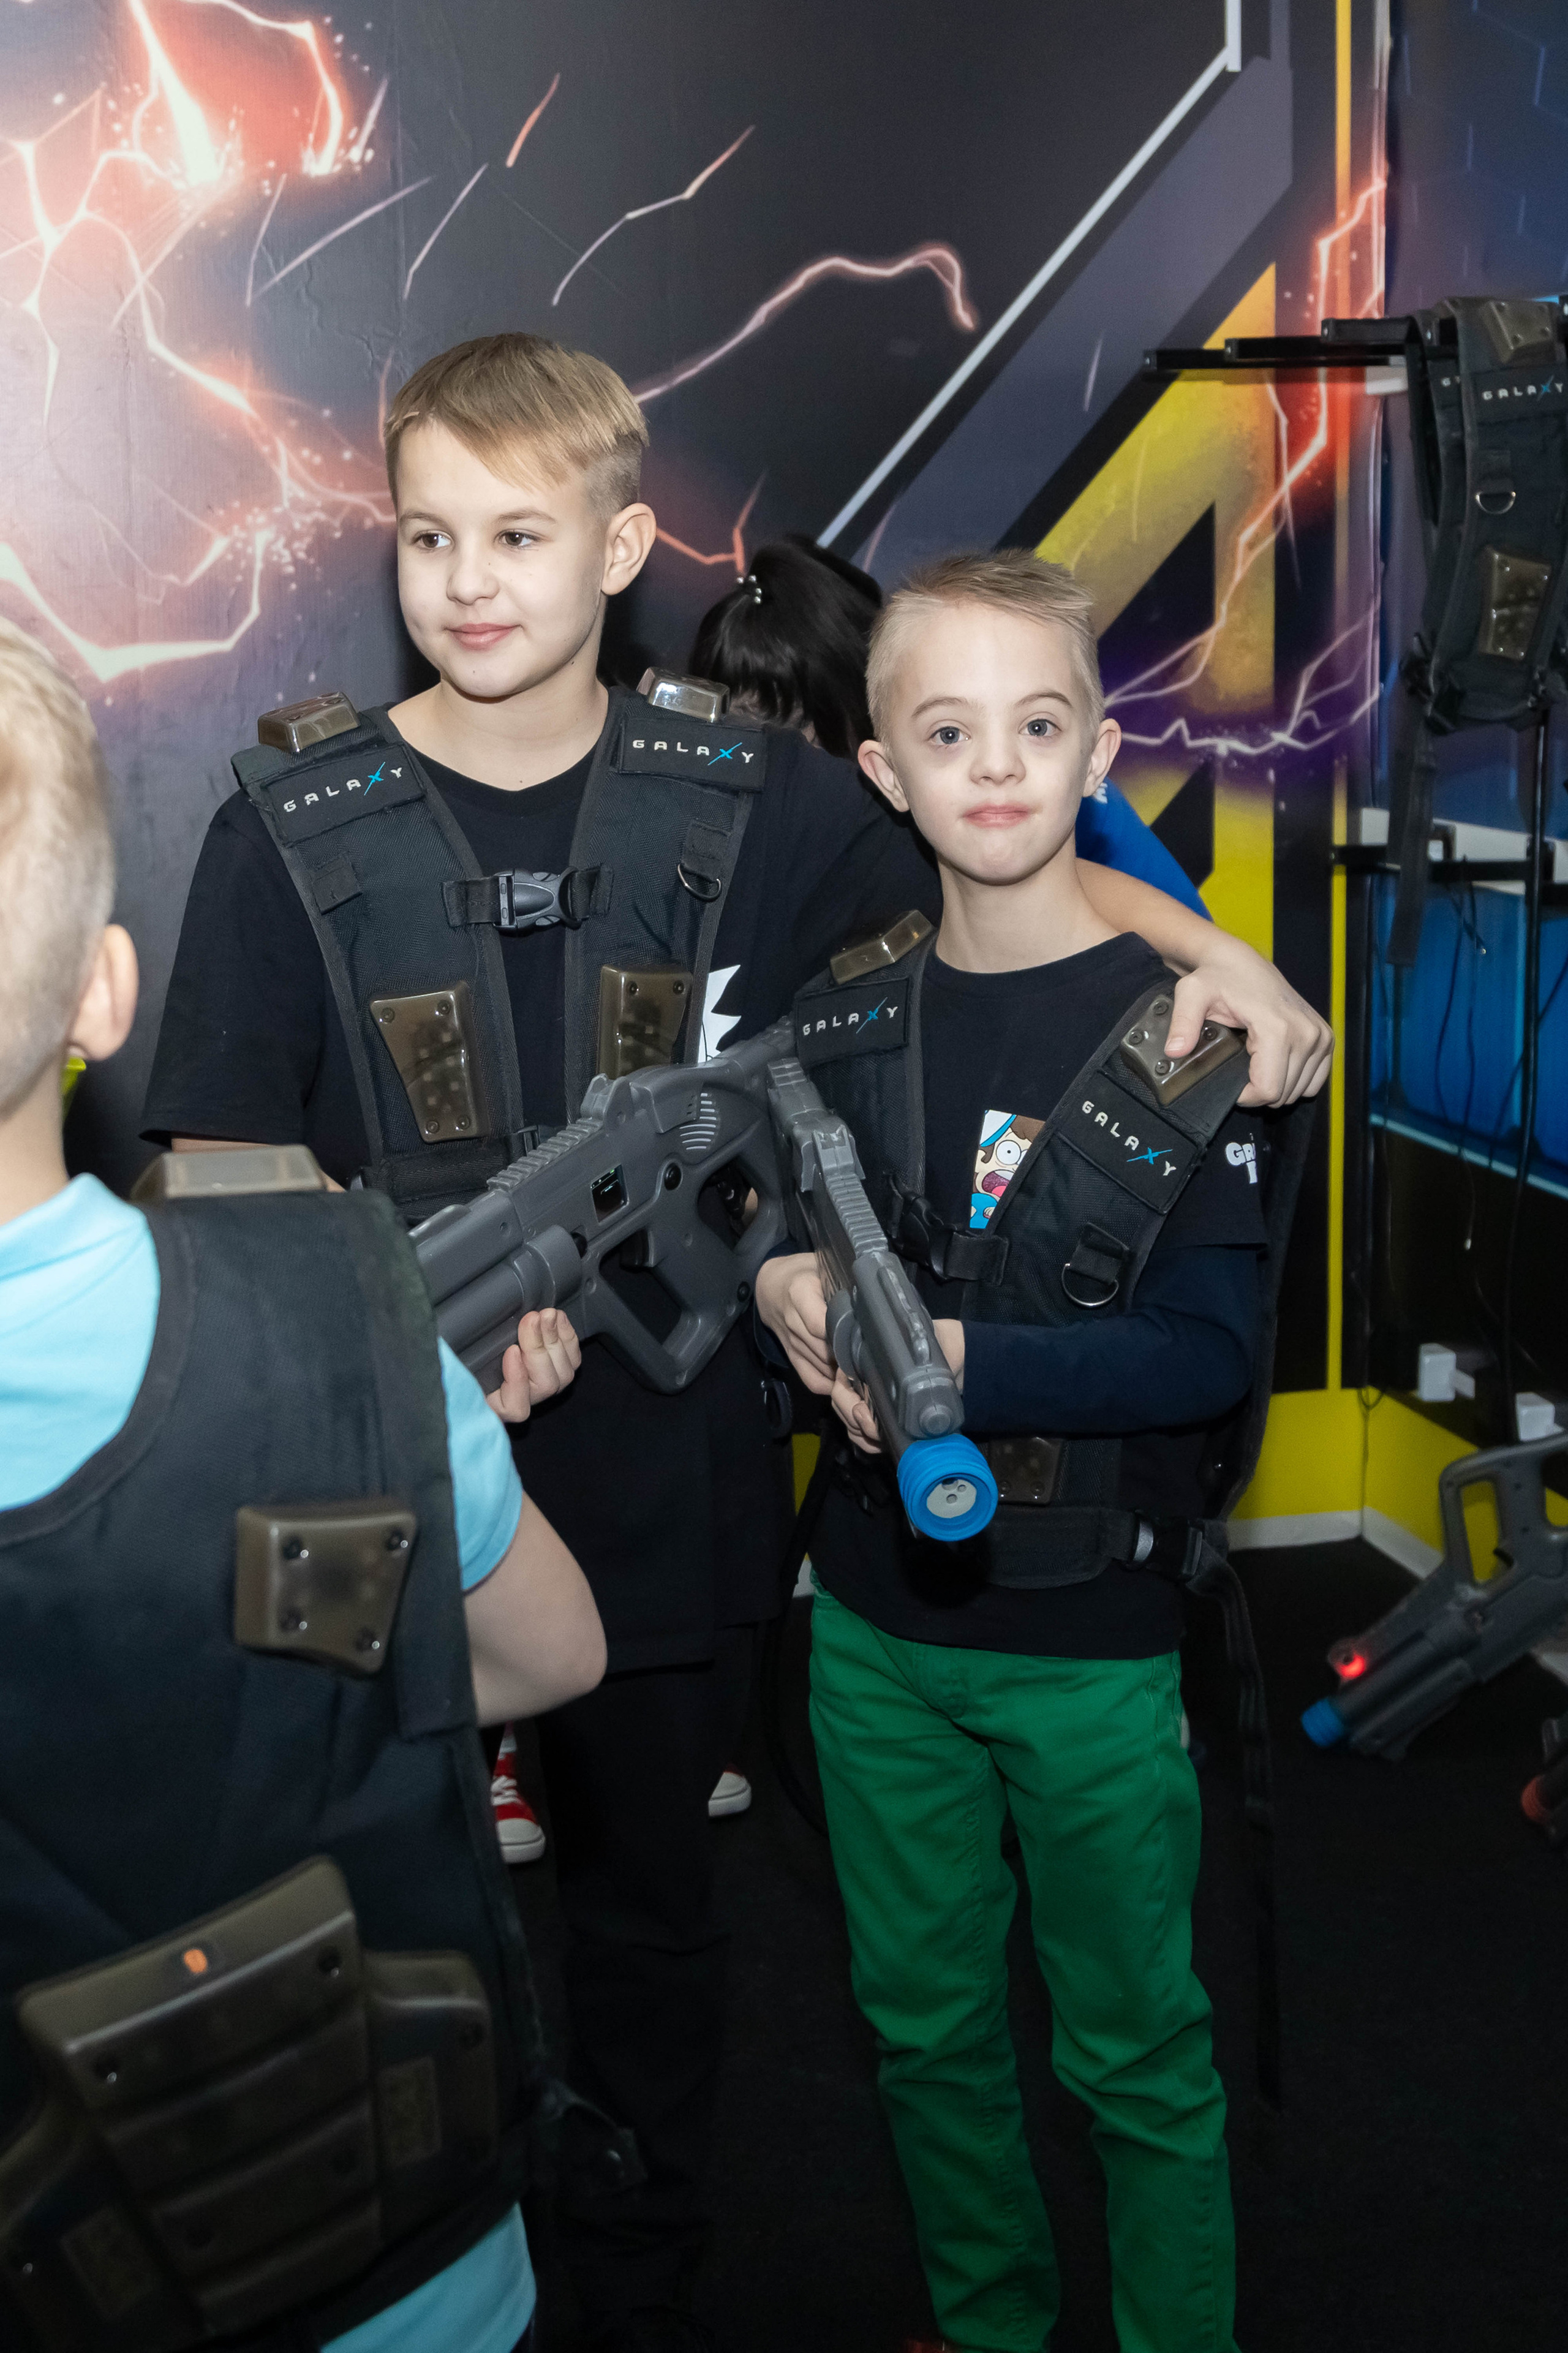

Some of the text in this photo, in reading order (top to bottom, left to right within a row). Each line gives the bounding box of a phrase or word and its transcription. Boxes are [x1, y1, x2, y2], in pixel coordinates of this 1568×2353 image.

[1482, 376, 1563, 401] GALAXY
[632, 739, 754, 766] GALAXY
[283, 761, 402, 812] GALAXY
[802, 997, 899, 1035] GALAXY
[1082, 1100, 1177, 1176] GALAXY
